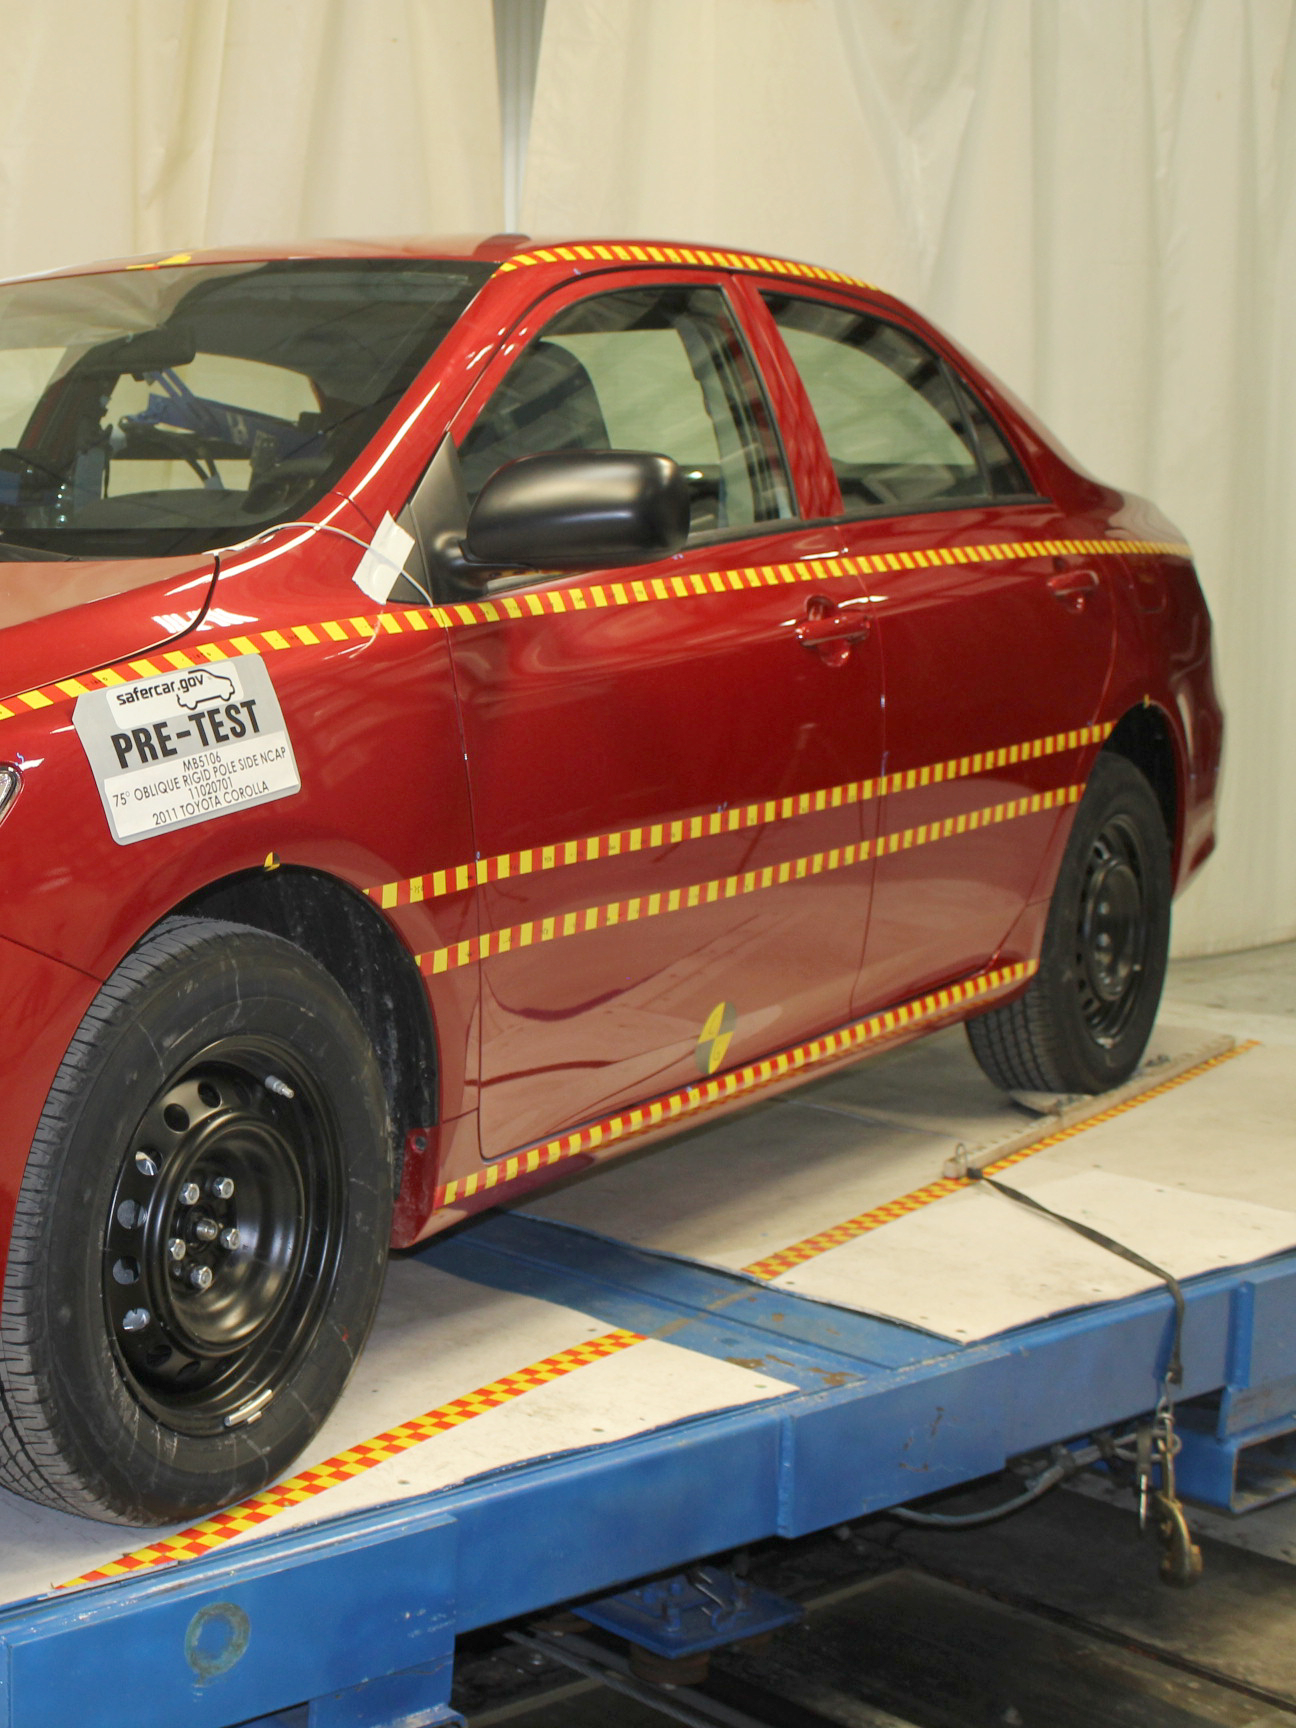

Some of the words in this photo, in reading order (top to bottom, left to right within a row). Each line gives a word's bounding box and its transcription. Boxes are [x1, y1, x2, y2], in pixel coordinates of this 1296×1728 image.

[116, 673, 204, 706] safercar.gov
[110, 699, 261, 769] PRE-TEST
[133, 777, 181, 801] OBLIQUE
[182, 768, 211, 788] RIGID
[212, 761, 238, 778] POLE
[238, 754, 260, 771] SIDE
[260, 746, 286, 765] NCAP
[182, 751, 222, 773] MB5106
[152, 807, 179, 826] 2011
[179, 795, 223, 817] TOYOTA
[223, 780, 270, 804] COROLLA
[188, 776, 234, 801] 11020701
